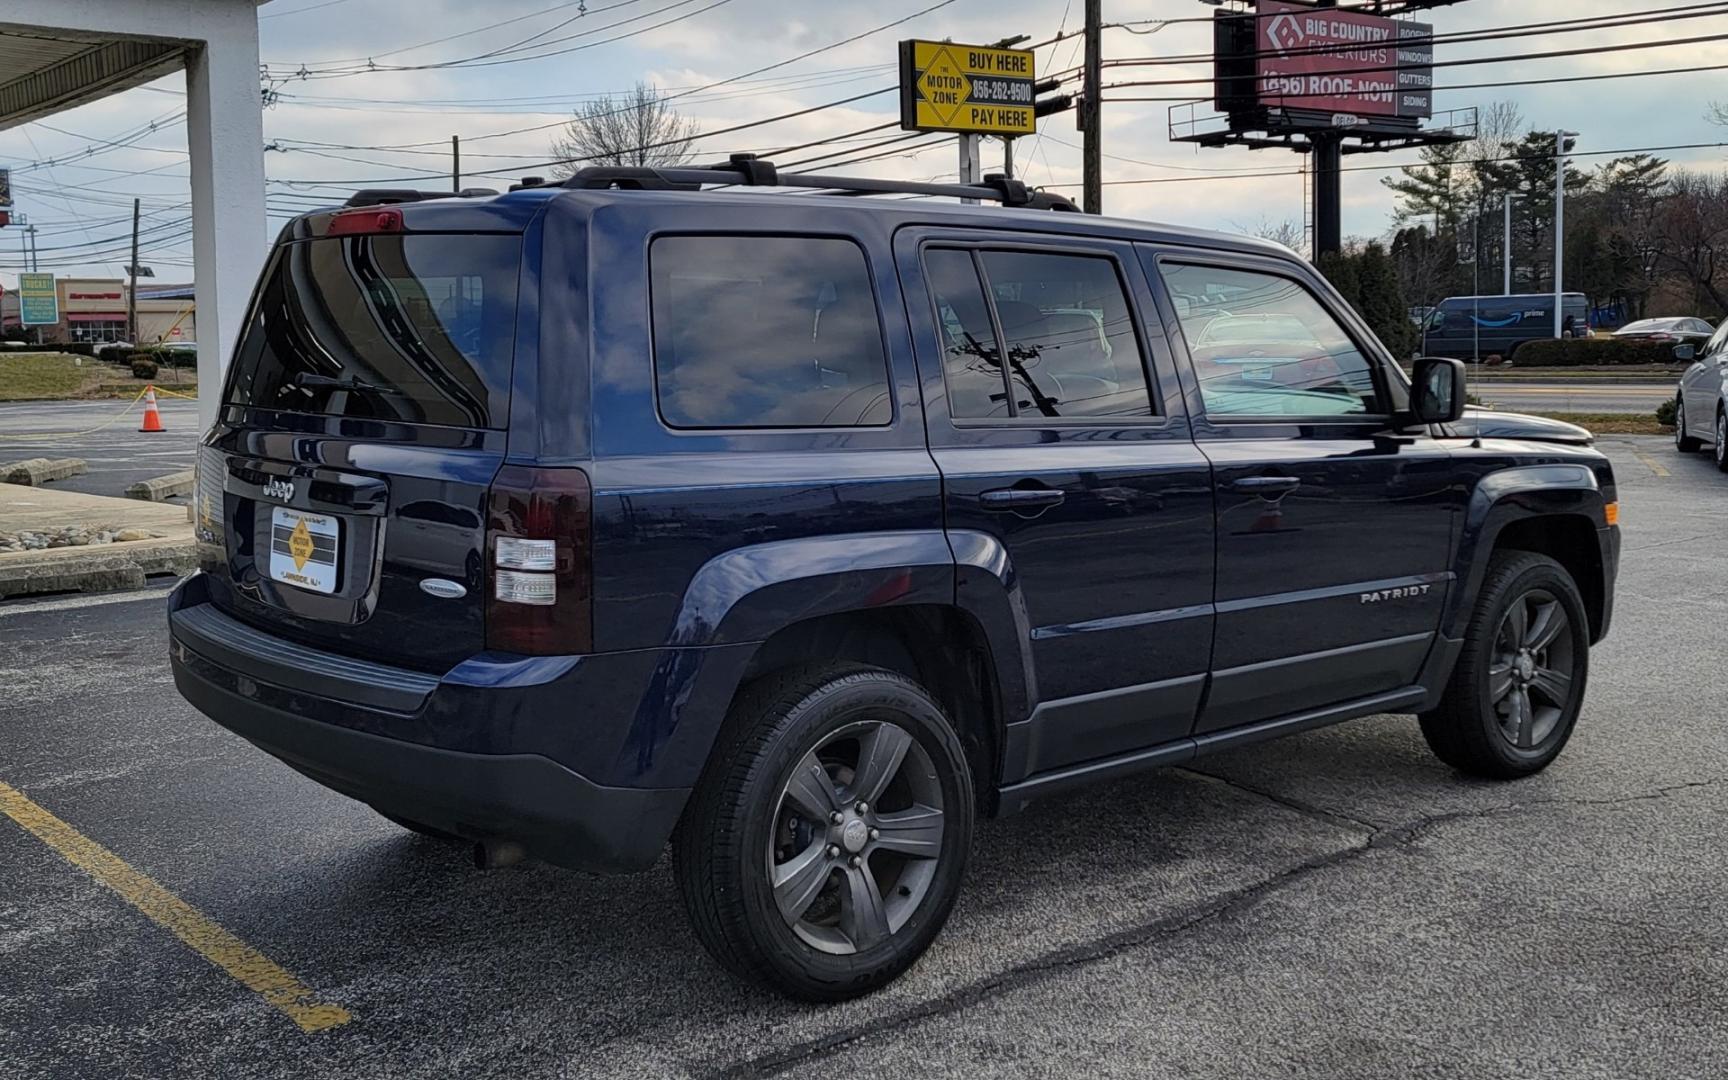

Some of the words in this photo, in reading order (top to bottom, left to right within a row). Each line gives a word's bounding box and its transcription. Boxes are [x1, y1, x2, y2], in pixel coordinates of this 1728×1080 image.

[1306, 18, 1327, 36] BIG
[1330, 21, 1389, 41] COUNTRY
[969, 52, 993, 70] BUY
[996, 54, 1027, 72] HERE
[1399, 50, 1432, 63] WINDOWS
[927, 75, 963, 90] MOTOR
[1263, 70, 1305, 96] (856)
[1399, 73, 1432, 86] GUTTERS
[932, 91, 958, 105] ZONE
[973, 79, 1031, 101] 856-262-9500
[1403, 95, 1427, 107] SIDING
[971, 108, 994, 126] PAY
[998, 109, 1028, 127] HERE
[1524, 309, 1544, 318] prime
[263, 475, 294, 503] Jeep
[1360, 584, 1431, 603] PATRIOT
